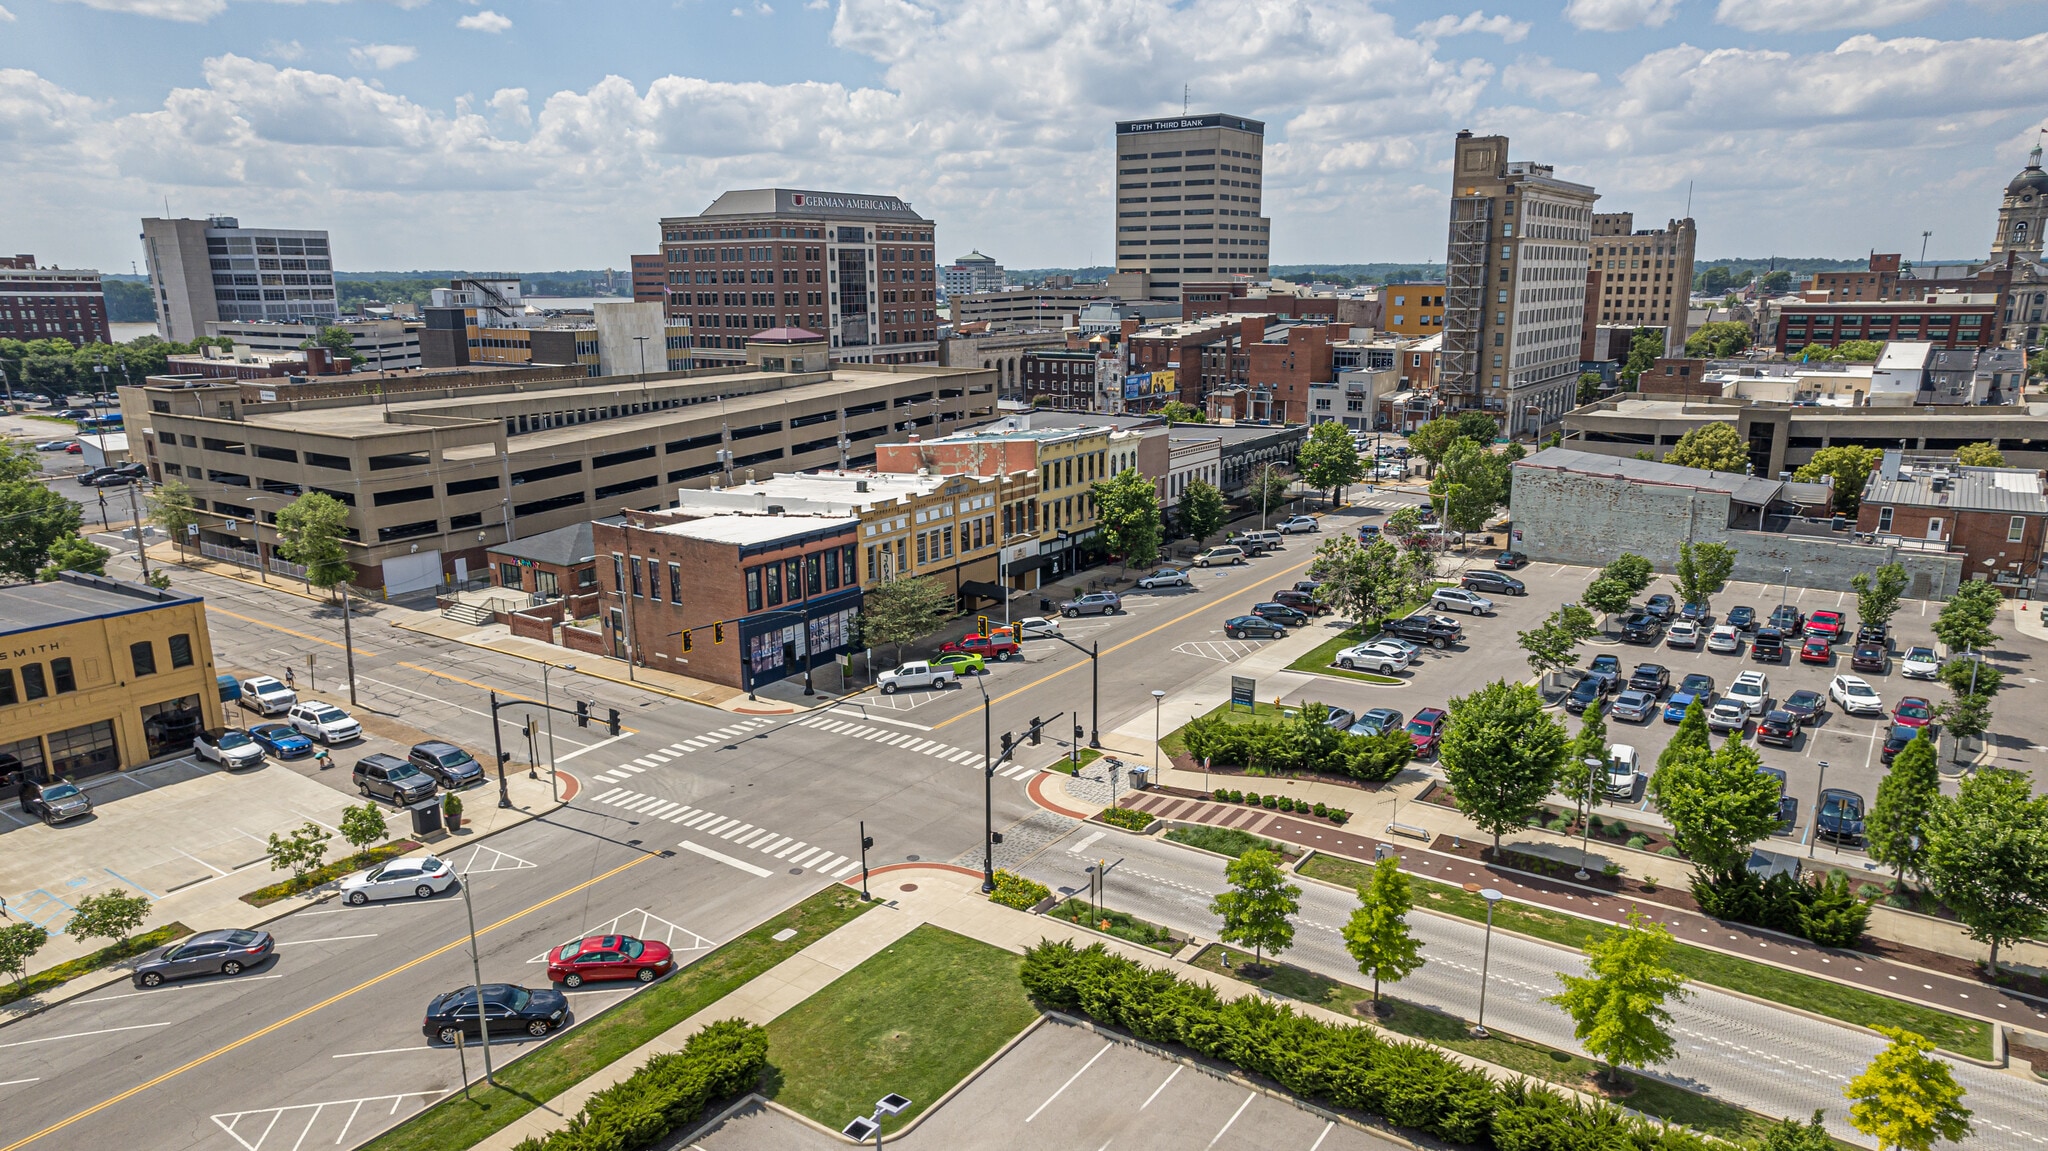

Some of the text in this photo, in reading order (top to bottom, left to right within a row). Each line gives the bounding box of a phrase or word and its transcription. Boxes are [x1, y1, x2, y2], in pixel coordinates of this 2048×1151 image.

[1131, 119, 1203, 131] FIFTH THIRD BANK
[805, 196, 912, 212] GERMAN AMERICAN BANK
[0, 642, 59, 660] SMITH
